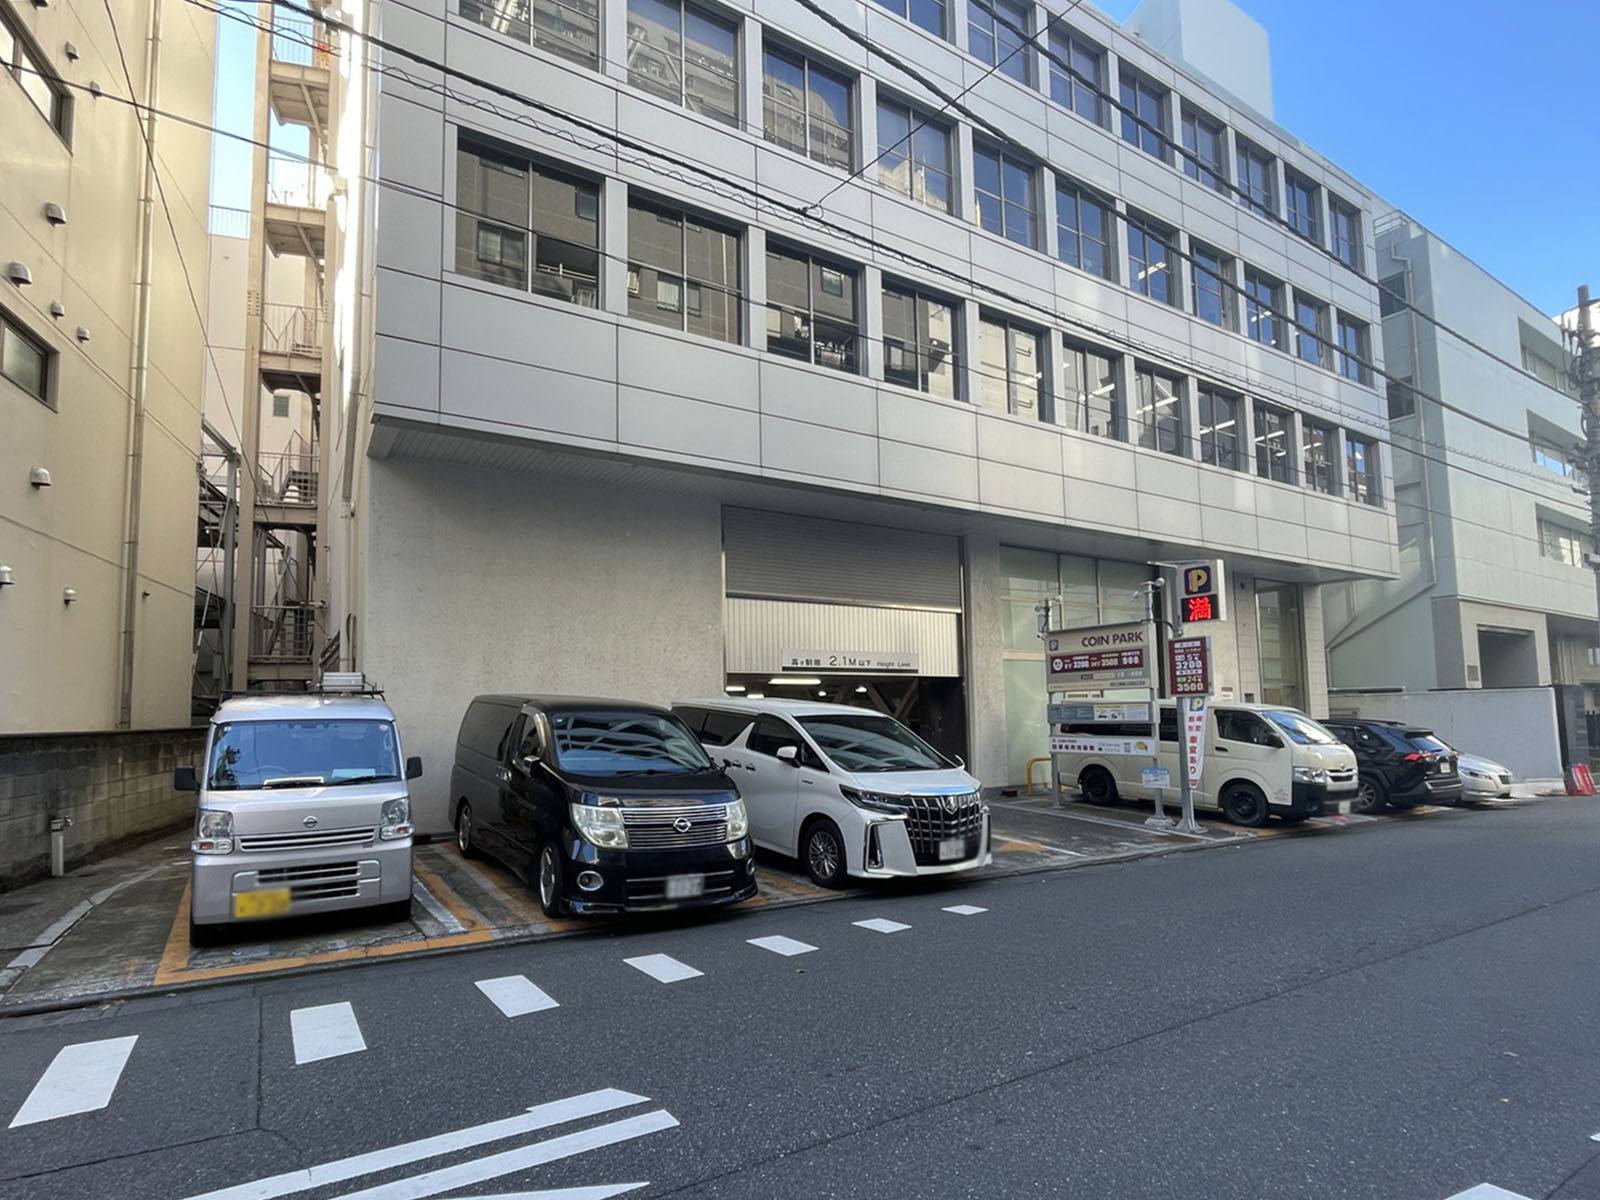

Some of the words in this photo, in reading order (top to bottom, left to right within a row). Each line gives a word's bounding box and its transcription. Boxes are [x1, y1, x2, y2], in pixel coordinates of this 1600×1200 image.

[1188, 596, 1212, 621] 満
[1081, 634, 1110, 648] COIN
[1112, 631, 1144, 645] PARK
[1176, 682, 1204, 692] 3500
